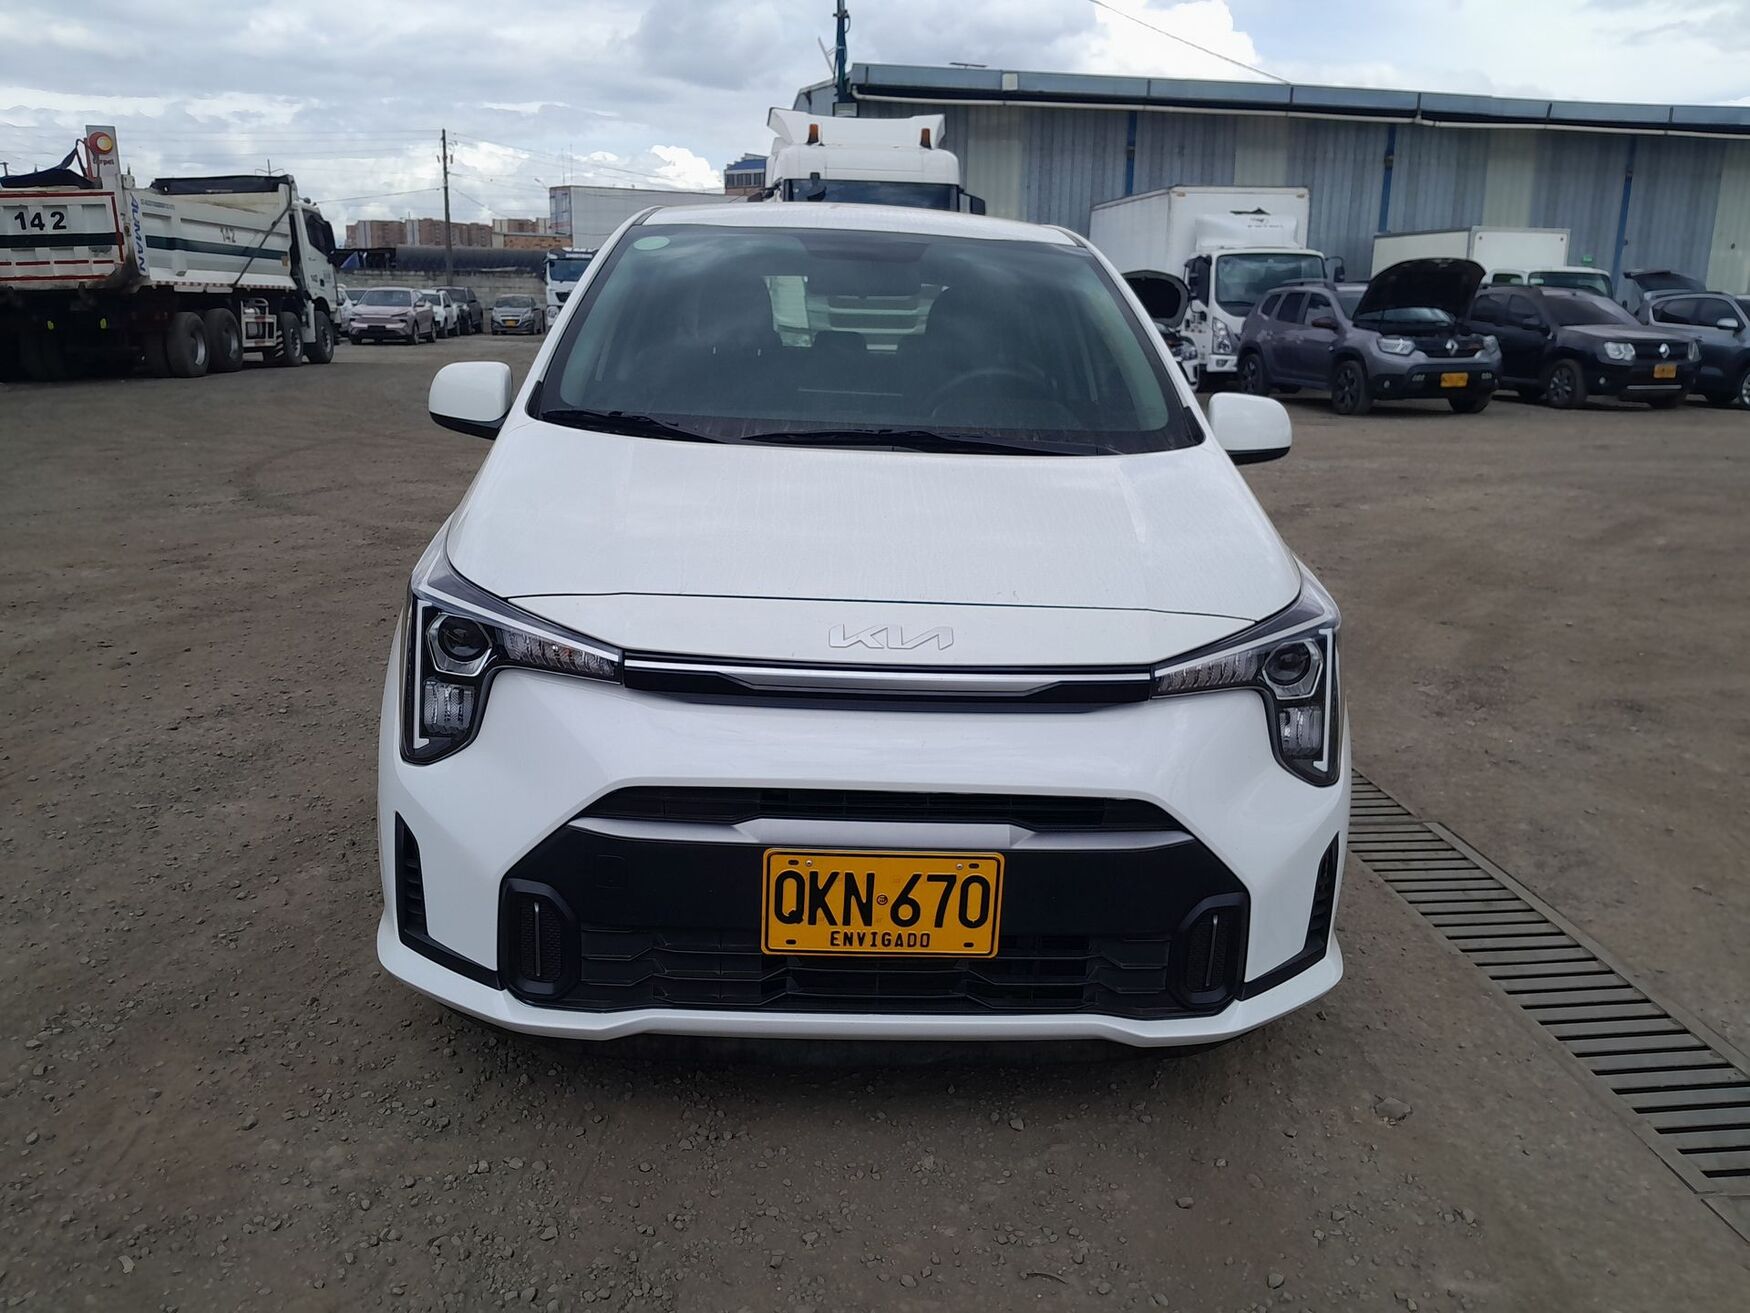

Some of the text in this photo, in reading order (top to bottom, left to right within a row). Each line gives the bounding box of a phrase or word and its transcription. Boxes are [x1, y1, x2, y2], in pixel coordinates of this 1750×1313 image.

[14, 211, 67, 231] 142
[130, 192, 146, 272] AUMAN
[828, 623, 954, 651] KIA
[774, 869, 991, 929] QKN 670
[829, 930, 931, 948] ENVIGADO
